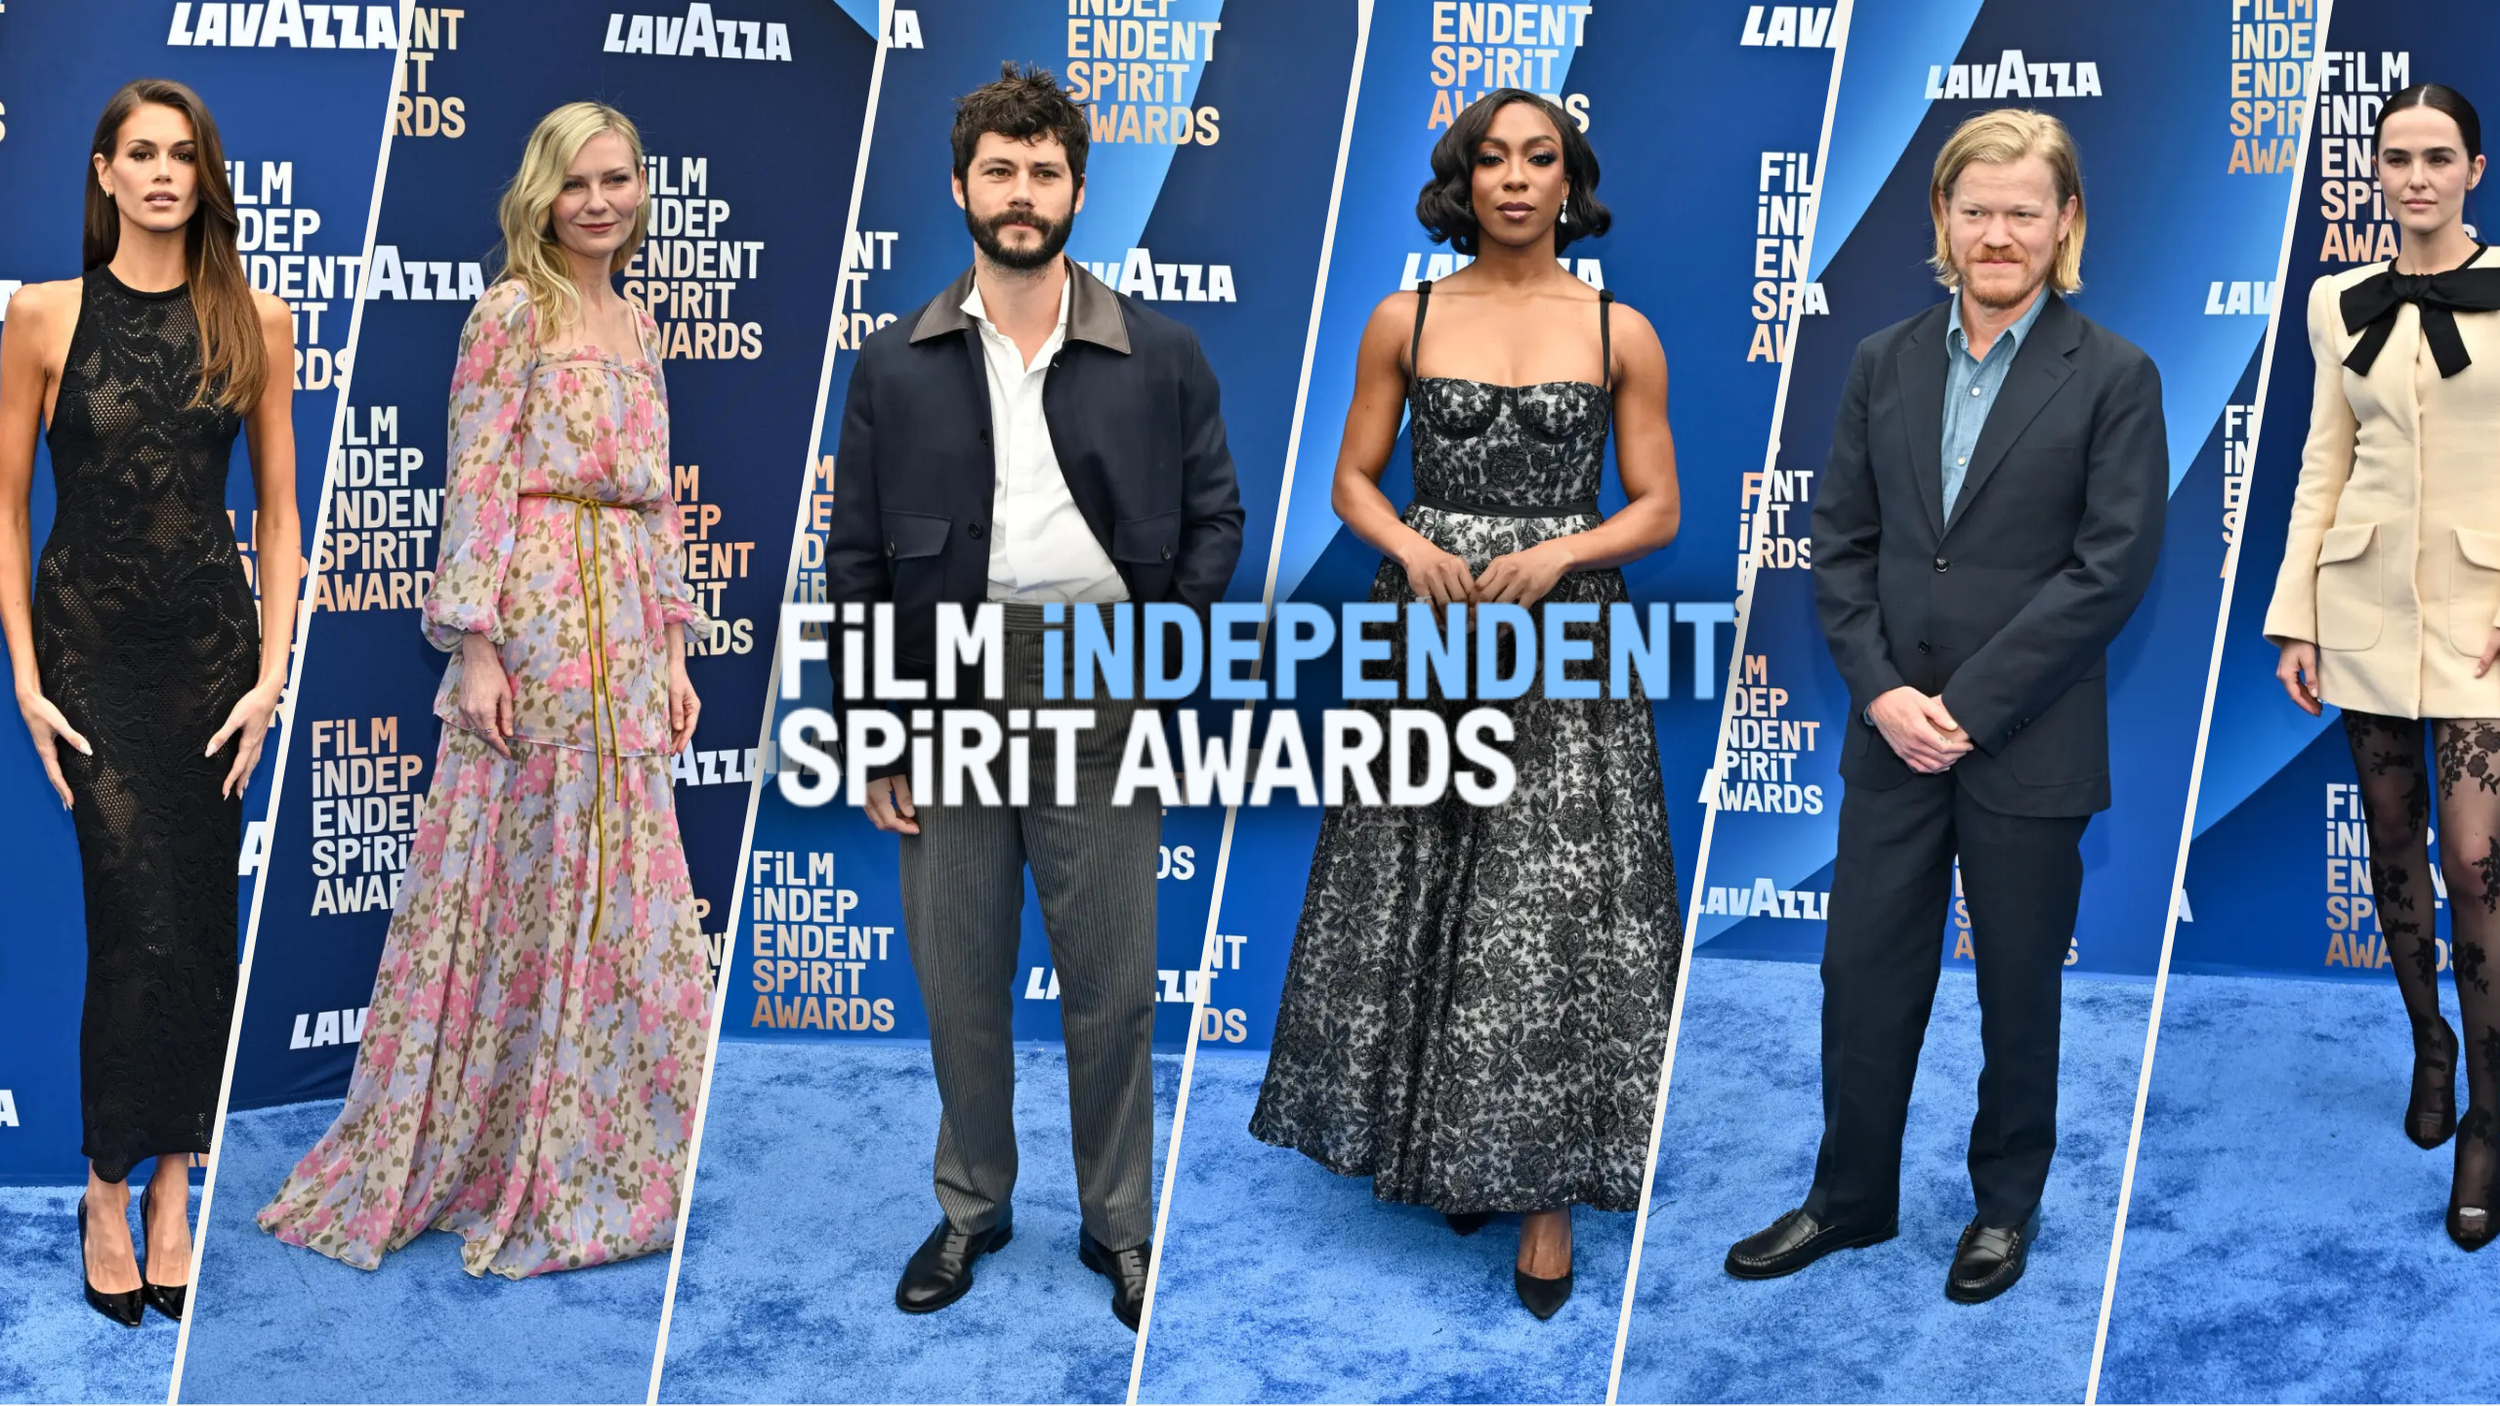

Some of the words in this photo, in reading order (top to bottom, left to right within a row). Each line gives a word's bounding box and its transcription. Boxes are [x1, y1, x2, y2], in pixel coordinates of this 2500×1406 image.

[167, 0, 399, 50] LAVAZZA
[603, 2, 792, 62] LAVAZZA
[1067, 18, 1222, 61] ENDENT
[1432, 1, 1593, 47] ENDENT
[2232, 22, 2317, 60] iNDE
[1924, 49, 2103, 99] LAVAZZA
[2319, 51, 2410, 92] FiLM
[1089, 103, 1220, 147] WARDS
[641, 156, 708, 196] iLM
[1759, 152, 1815, 193] FiL
[236, 208, 321, 252] DEP
[332, 448, 424, 488] NDEP
[311, 571, 436, 613] AWARD
[311, 716, 398, 758] FiLM
[1727, 719, 1820, 751] NDENT
[312, 755, 423, 799] iNDEP
[1722, 750, 1797, 783] PiRiT
[312, 833, 418, 877] SPiRi
[753, 850, 834, 887] FiLM
[753, 887, 859, 923] iNDEP
[753, 923, 895, 960] ENDENT
[752, 959, 866, 995] SPiRiT
[750, 995, 896, 1032] AWARDS
